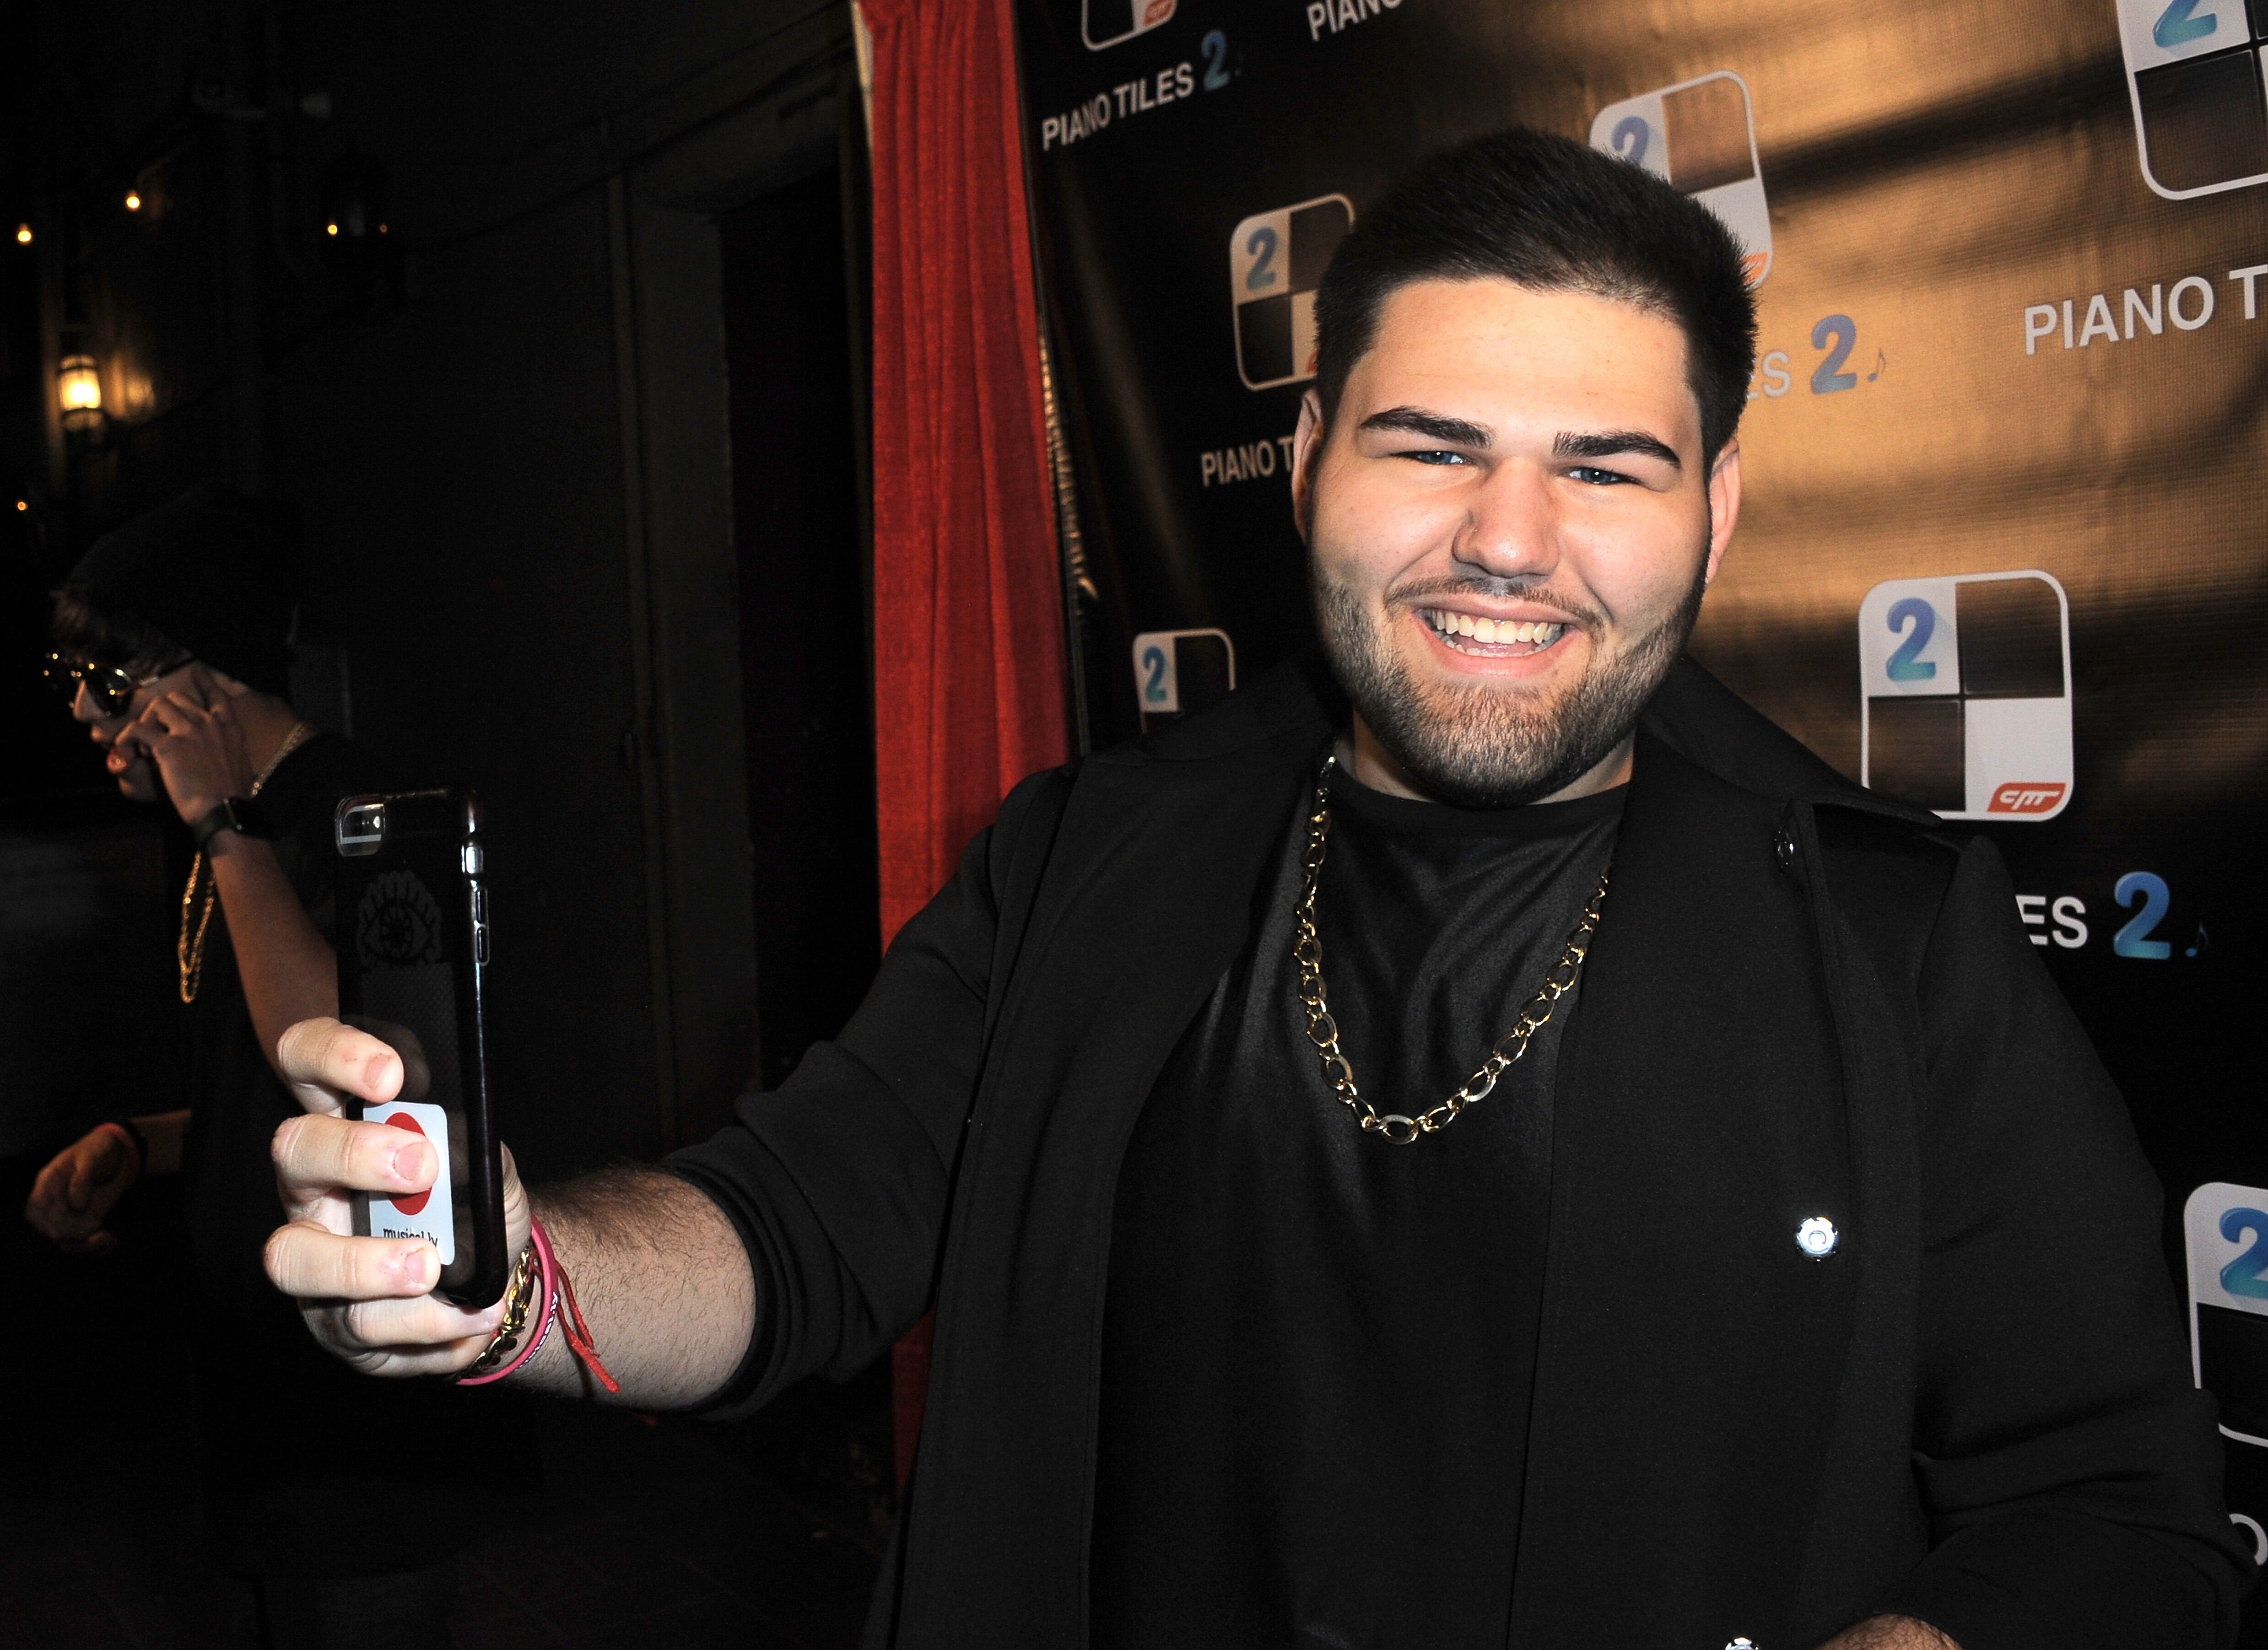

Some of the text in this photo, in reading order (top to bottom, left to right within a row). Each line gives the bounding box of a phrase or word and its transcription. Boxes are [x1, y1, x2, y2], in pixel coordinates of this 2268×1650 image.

[1307, 0, 1403, 41] PIA
[1042, 28, 1231, 151] PIANO TILES 2
[1246, 226, 1277, 291] 2
[1811, 314, 1857, 395] 2
[2024, 276, 2214, 356] PIANO
[1200, 439, 1276, 487] PIANO
[1143, 645, 1166, 703] 2
[1886, 597, 1937, 682] 2
[2113, 870, 2171, 960] 2
[2219, 1207, 2268, 1299] 2
